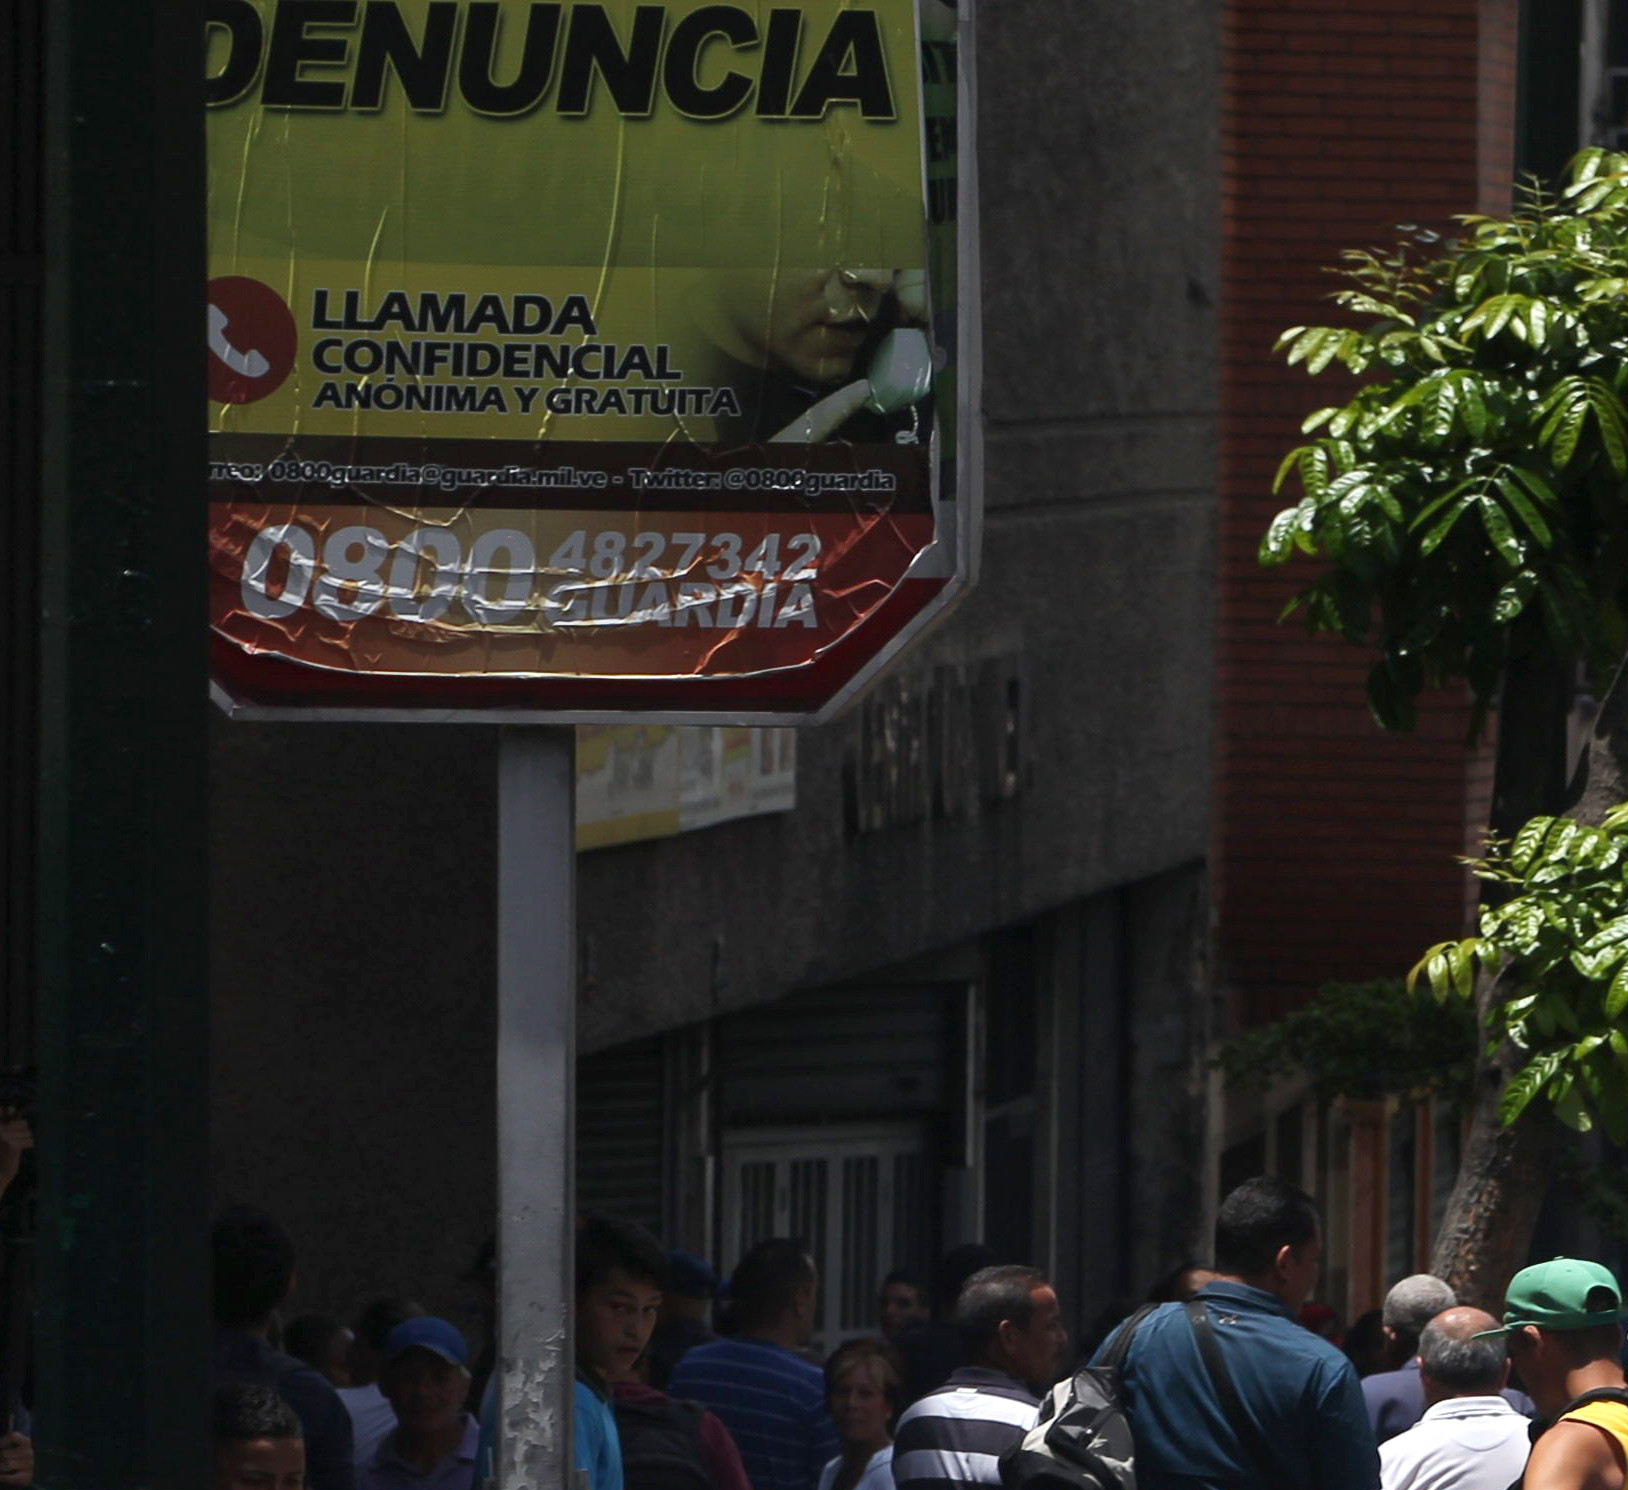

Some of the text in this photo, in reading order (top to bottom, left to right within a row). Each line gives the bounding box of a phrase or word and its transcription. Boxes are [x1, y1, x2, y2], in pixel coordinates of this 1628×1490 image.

[205, 0, 897, 119] DENUNCIA
[311, 288, 597, 336] LLAMADA
[311, 338, 682, 381] CONFIDENCIAL
[311, 376, 741, 416] ANÓNIMA Y GRATUITA
[269, 461, 607, 490] 0800guardia@guardia.mil.ve
[628, 468, 723, 490] Twitter:
[724, 469, 896, 495] @0800guardia
[239, 525, 822, 628] 0800 4827342
[547, 580, 819, 629] GUARDIA
